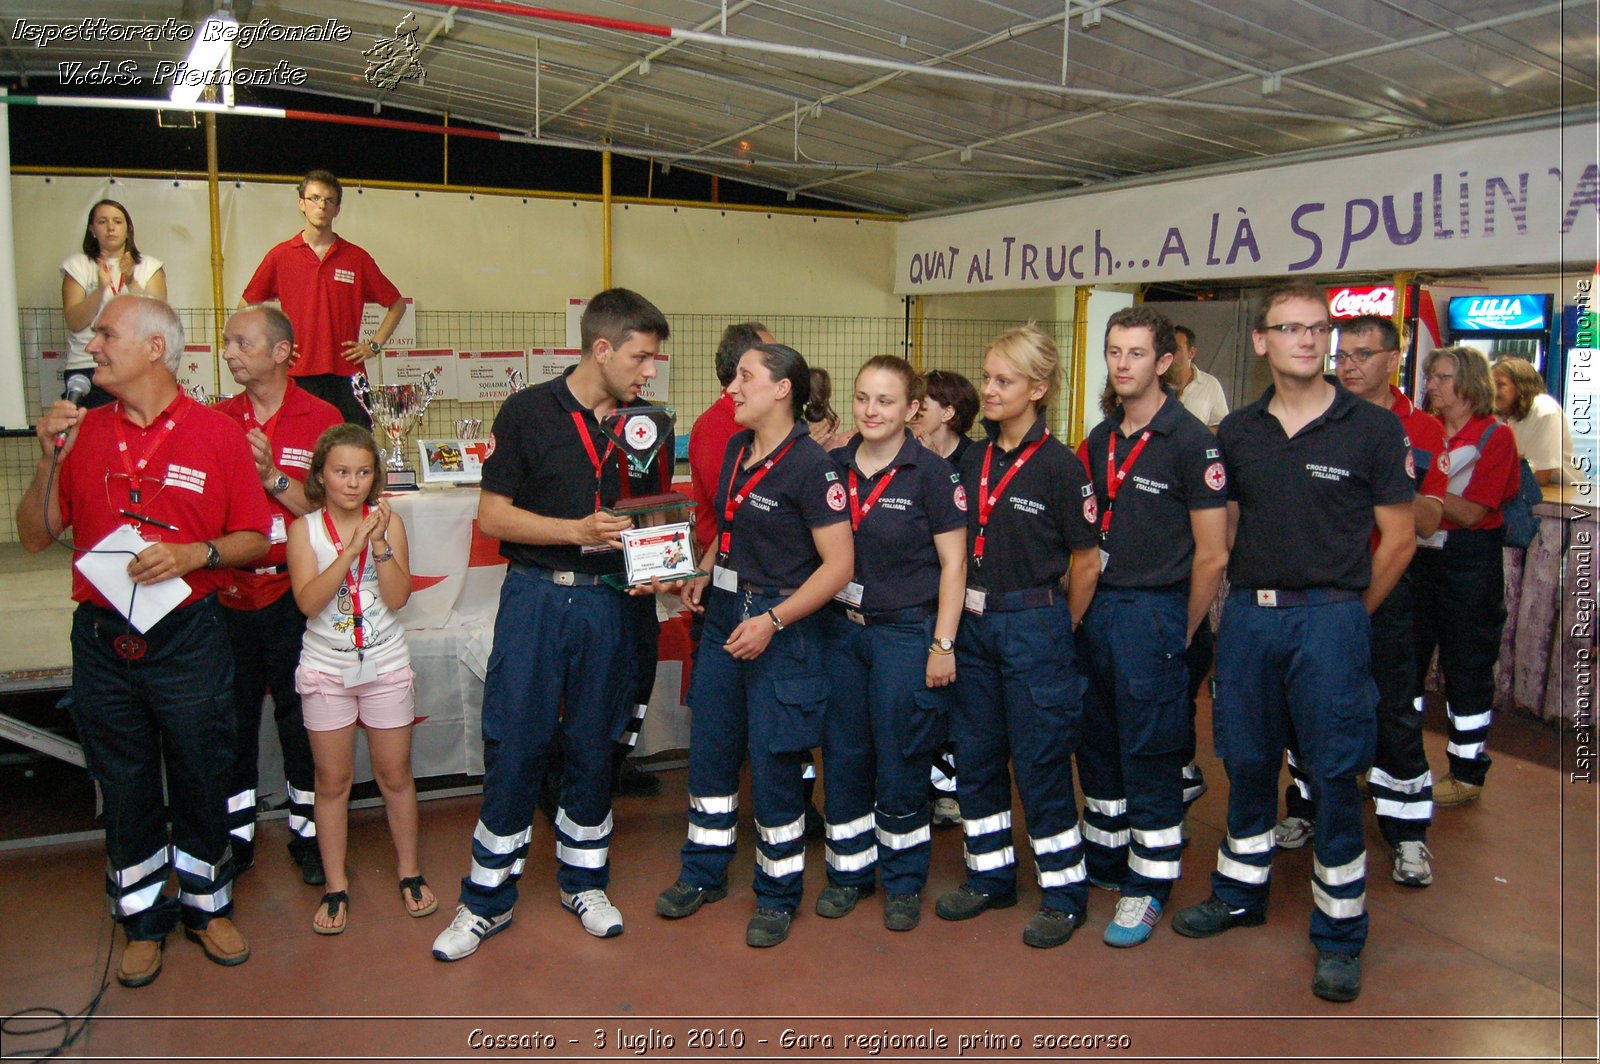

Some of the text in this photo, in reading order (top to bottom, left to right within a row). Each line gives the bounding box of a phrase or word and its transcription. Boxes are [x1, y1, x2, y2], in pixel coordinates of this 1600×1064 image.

[909, 247, 960, 284] QUAT
[1468, 299, 1522, 317] LILIA
[1305, 463, 1350, 477] CROCE ROSSA
[1311, 471, 1340, 481] ITALIANA
[1132, 475, 1150, 485] CROCE
[1009, 496, 1028, 505] CROCE
